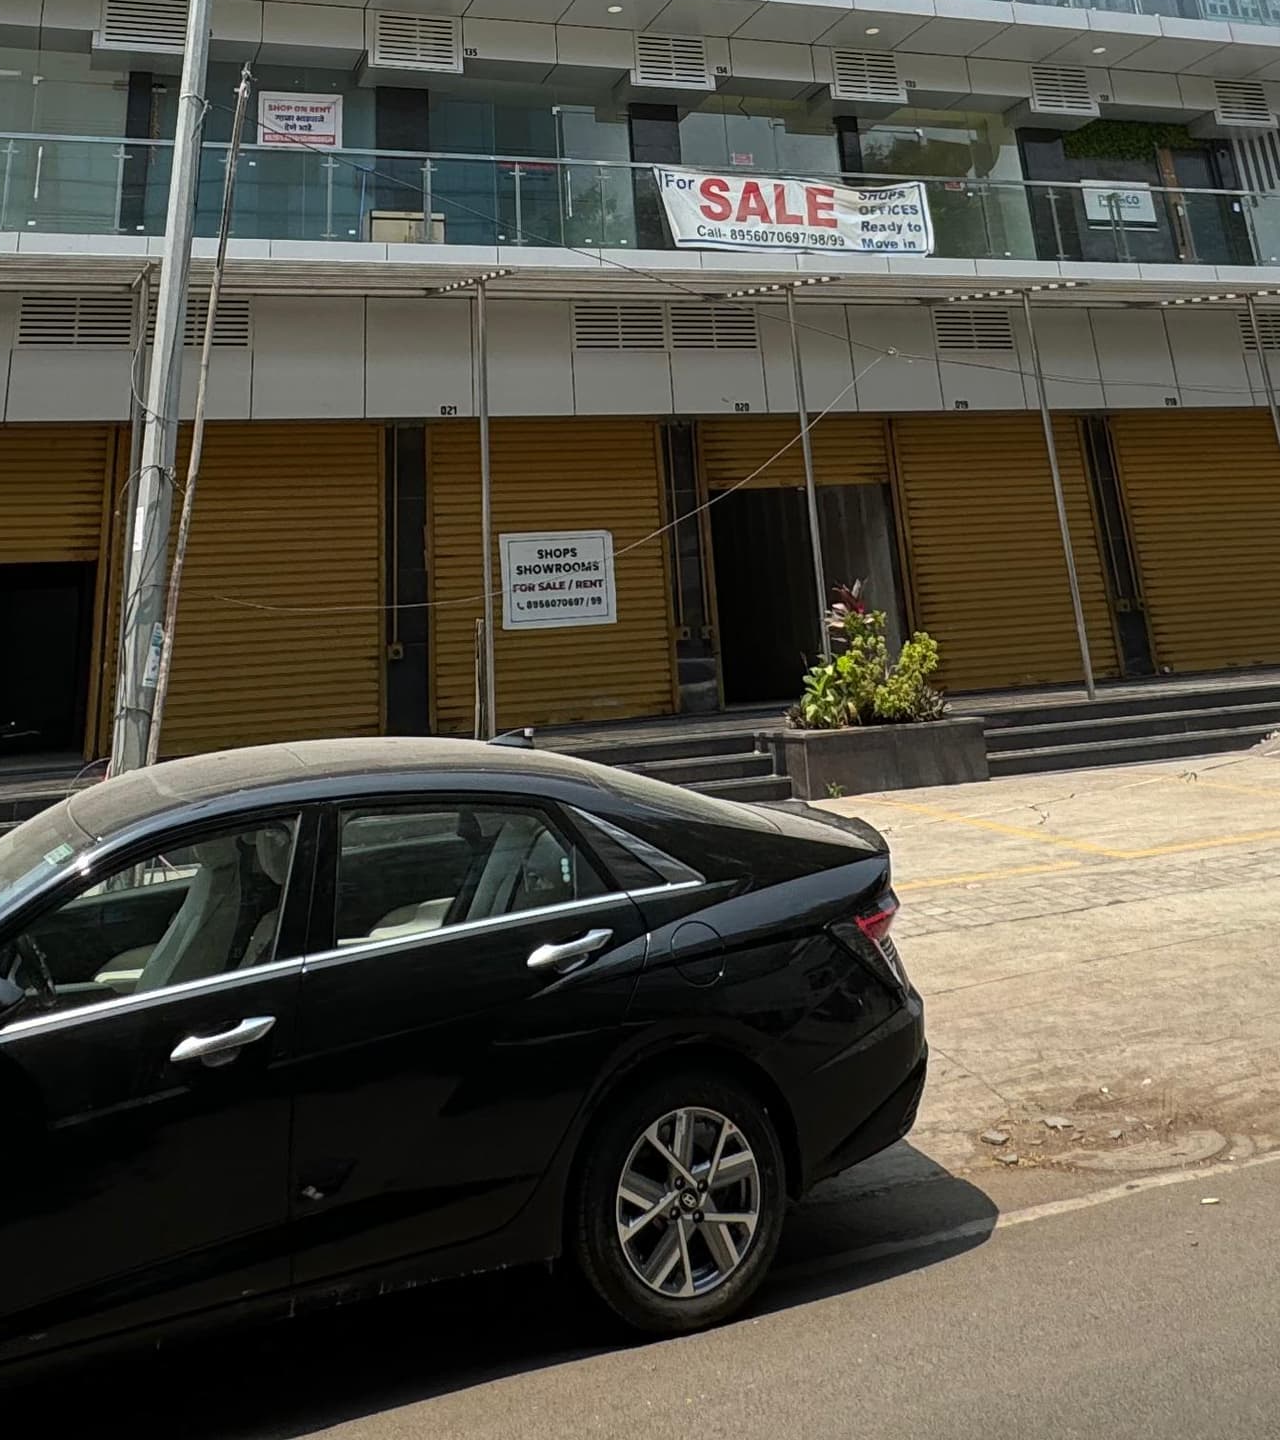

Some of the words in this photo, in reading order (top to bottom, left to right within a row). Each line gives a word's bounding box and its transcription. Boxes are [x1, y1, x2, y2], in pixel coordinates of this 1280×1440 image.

[309, 105, 332, 114] RENT
[664, 174, 695, 190] For
[699, 178, 838, 229] SALE
[859, 204, 919, 215] OFFICES
[861, 221, 903, 234] Ready
[907, 222, 922, 232] to
[861, 238, 899, 249] Move
[903, 238, 916, 249] in
[440, 406, 457, 415] 021
[537, 547, 577, 559] SHOPS
[516, 560, 600, 575] SHOWROOMS
[513, 583, 535, 593] FOR
[538, 580, 566, 591] SALE
[575, 579, 604, 589] RENT
